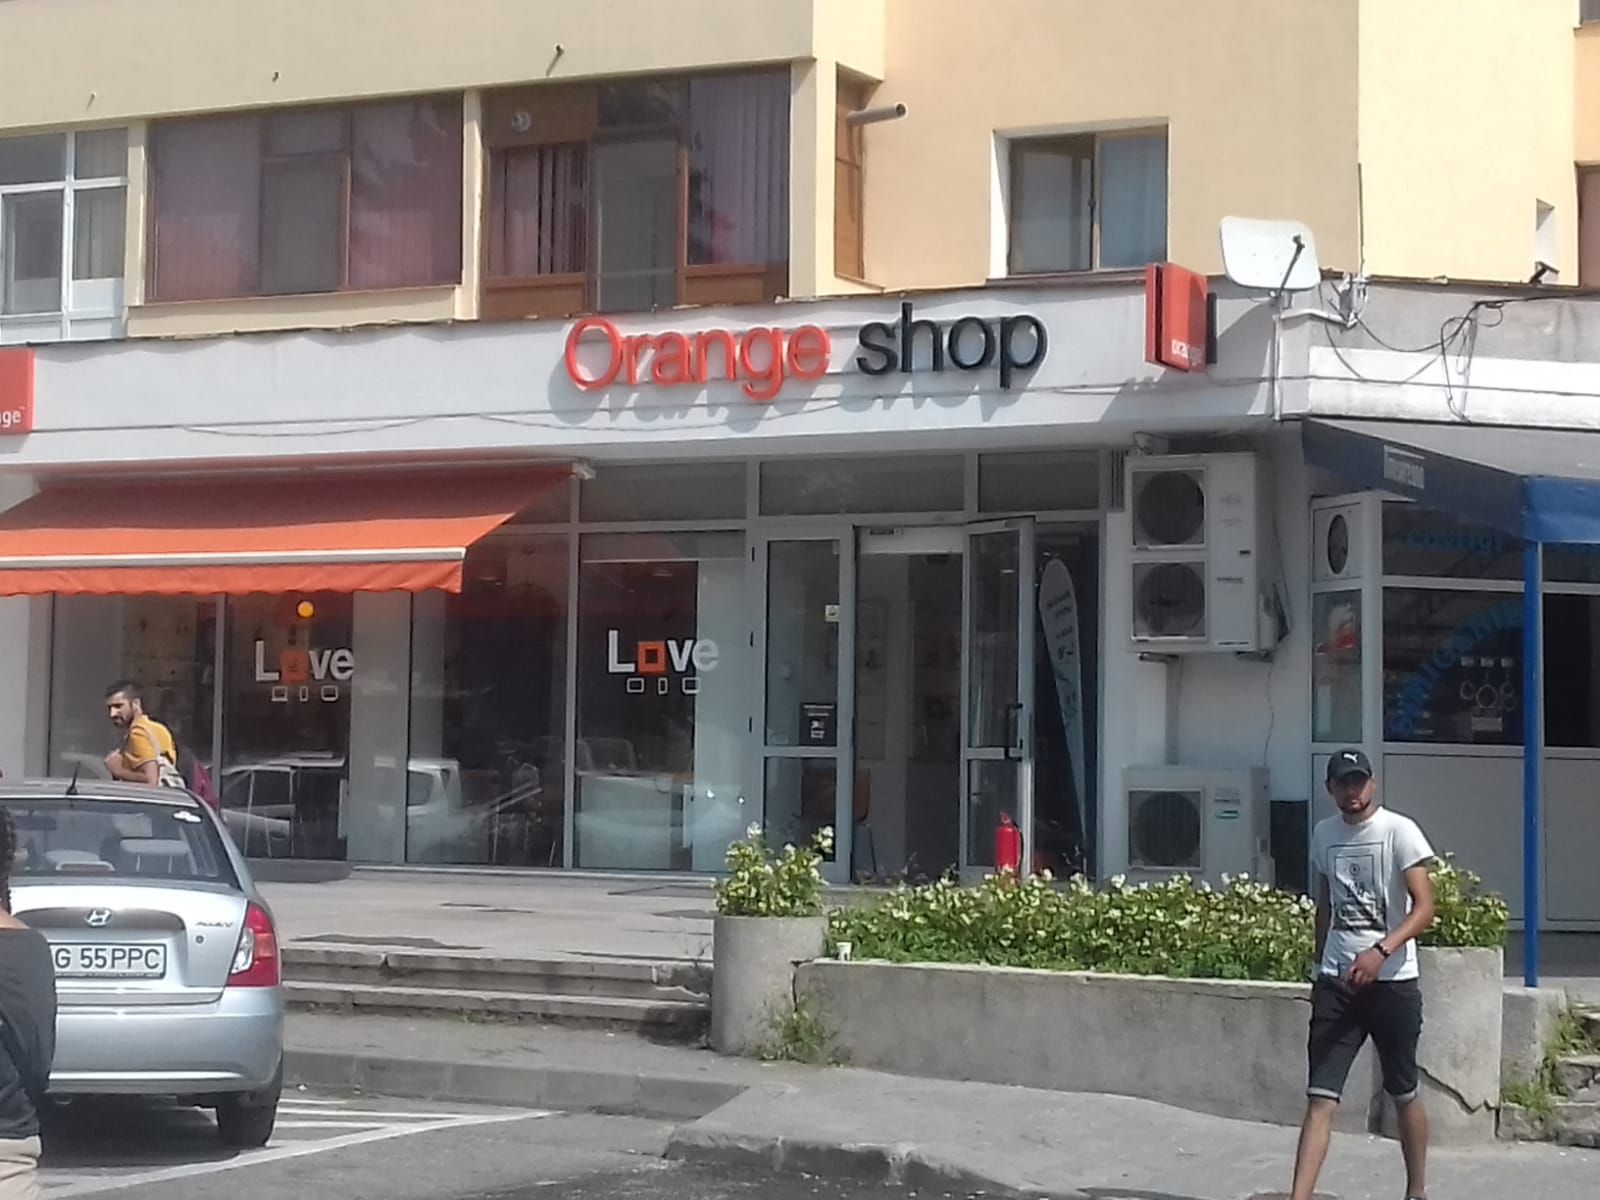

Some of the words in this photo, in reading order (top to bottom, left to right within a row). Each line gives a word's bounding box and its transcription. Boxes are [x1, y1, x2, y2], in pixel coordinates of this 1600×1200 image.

[565, 316, 831, 402] Orange
[856, 302, 1047, 389] shop
[0, 410, 22, 428] ge
